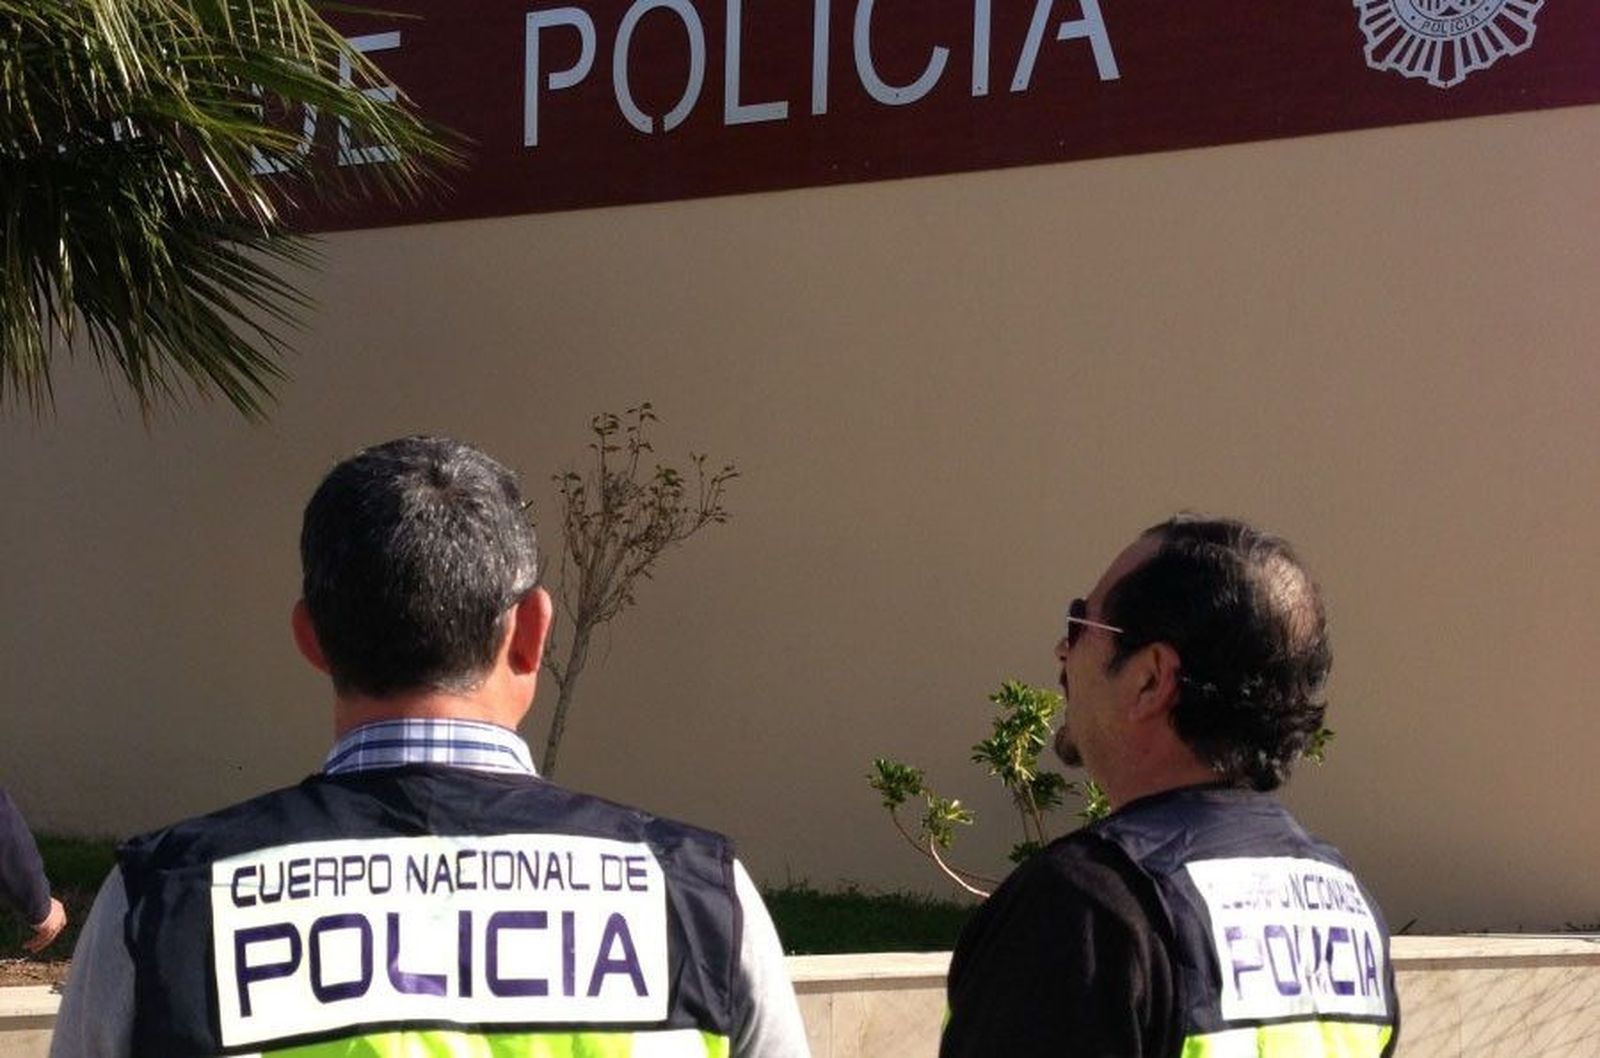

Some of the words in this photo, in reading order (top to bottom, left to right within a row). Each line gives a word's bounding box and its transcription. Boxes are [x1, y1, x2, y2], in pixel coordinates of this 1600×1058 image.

[1421, 14, 1479, 34] POLICIA
[524, 0, 1120, 146] POLICIA
[231, 854, 392, 908] CUERPO
[406, 850, 590, 894] NACIONAL
[600, 854, 649, 892] DE
[234, 911, 649, 1018] POLICIA
